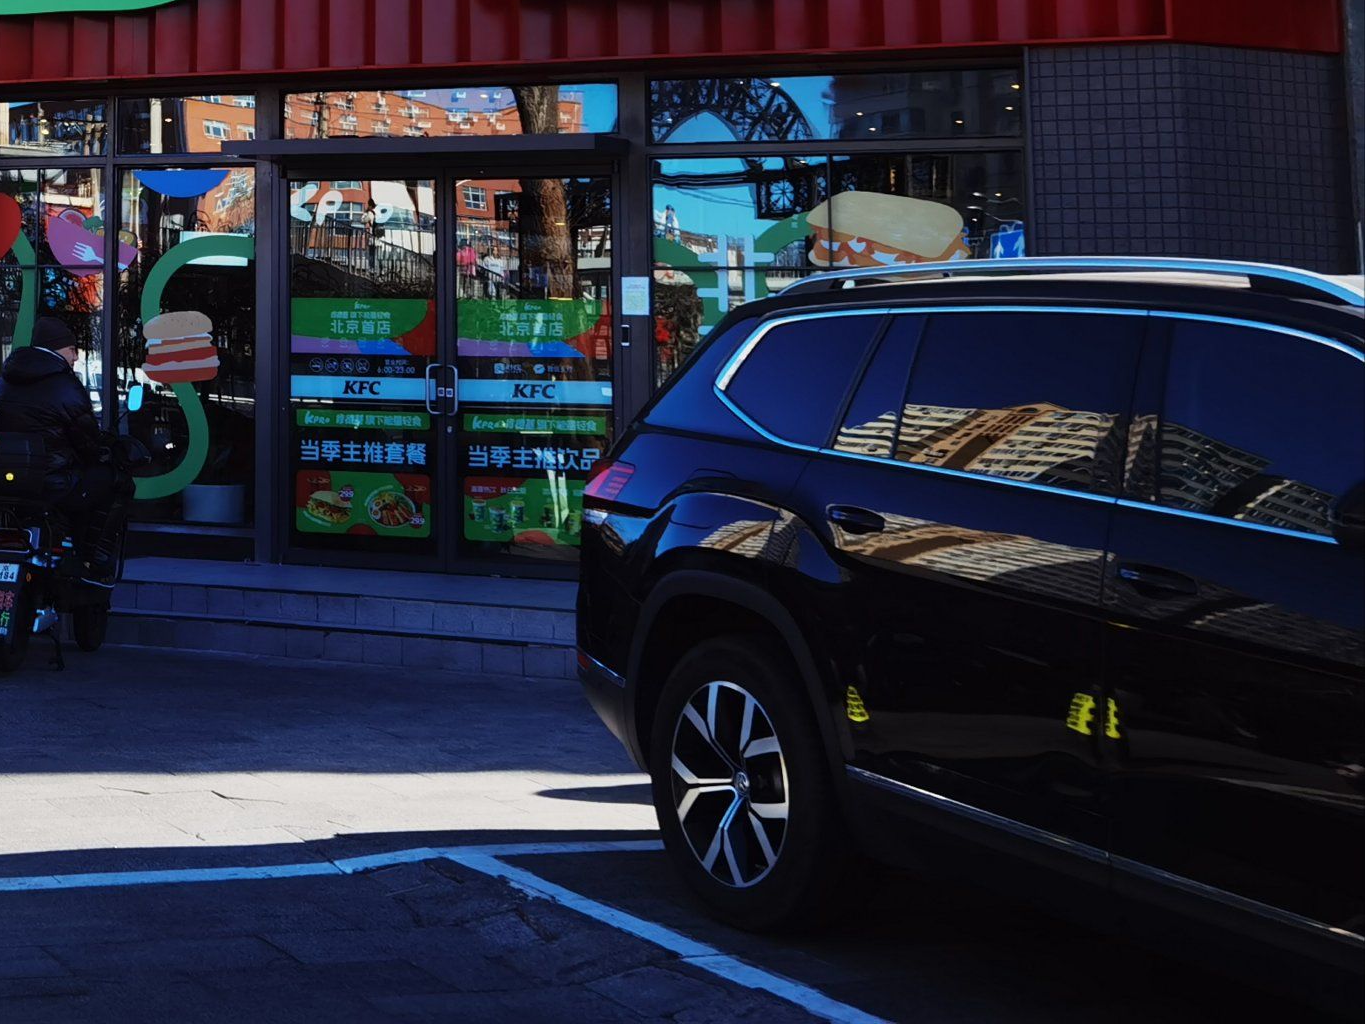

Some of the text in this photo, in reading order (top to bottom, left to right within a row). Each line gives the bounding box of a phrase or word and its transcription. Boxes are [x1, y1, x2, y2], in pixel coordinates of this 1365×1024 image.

[330, 320, 391, 335] 北京首店
[342, 380, 381, 395] KFC
[512, 383, 556, 399] KFC
[300, 439, 427, 465] 当季主推套餐
[468, 444, 601, 471] 当季主推饮品
